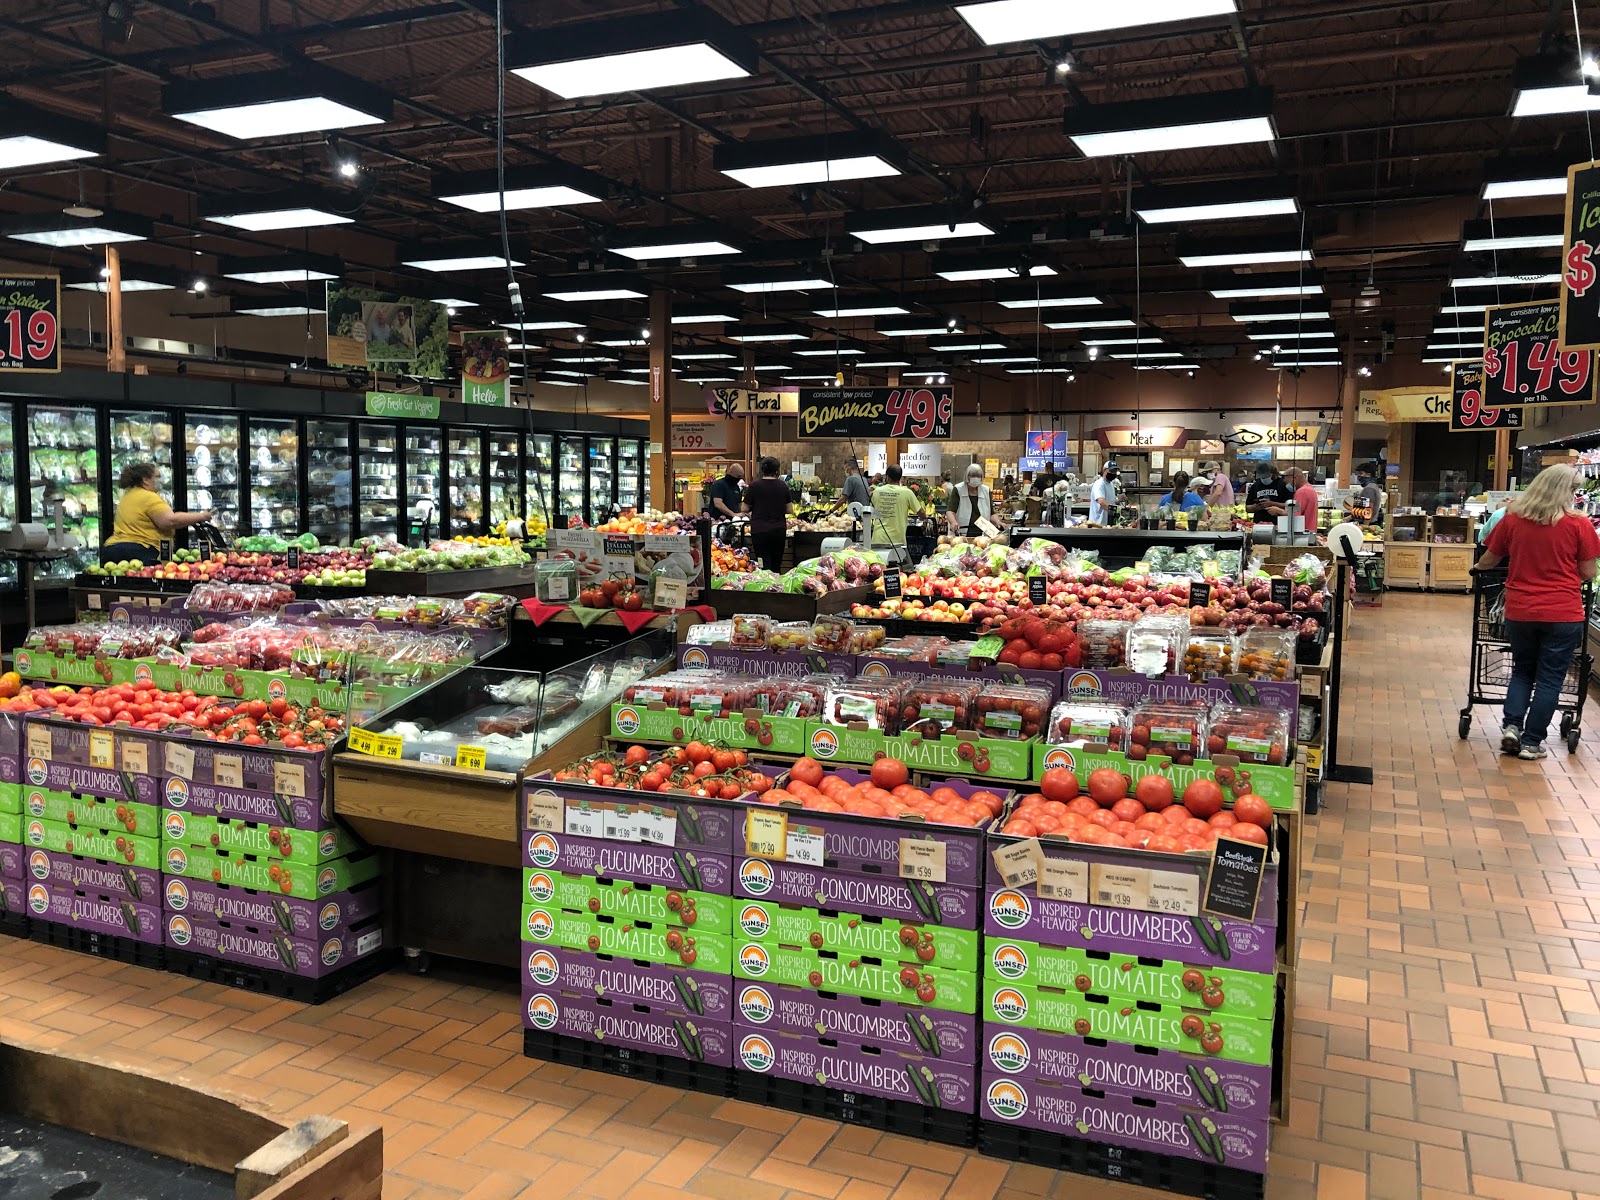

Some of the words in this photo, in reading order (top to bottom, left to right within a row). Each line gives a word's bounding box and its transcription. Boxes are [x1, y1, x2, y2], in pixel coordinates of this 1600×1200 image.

[8, 291, 51, 310] Salad
[1510, 307, 1540, 316] consistent
[1541, 306, 1552, 314] low
[1488, 317, 1544, 348] Broccoli
[1484, 339, 1591, 394] $1.49
[472, 385, 498, 404] Hello
[748, 393, 780, 411] Floral
[854, 390, 874, 399] prices!
[388, 398, 402, 411] Fresh
[404, 400, 413, 410] Cut
[414, 400, 434, 416] Veggies
[801, 402, 884, 434] Bananas
[936, 426, 946, 435] lb.
[1130, 432, 1154, 446] Meat
[1266, 428, 1308, 443] Seafood
[56, 660, 96, 678] TOMATES
[714, 656, 740, 666] INSPIRED
[744, 660, 810, 676] CONCOMBRES
[180, 673, 226, 692] TOMATOES
[1069, 688, 1100, 696] SUNSET
[1108, 680, 1142, 695] INSPIRED
[1148, 683, 1232, 704] CUCUMBERS
[644, 716, 674, 726] INSPIRED
[680, 716, 746, 742] TOMATOES
[812, 742, 838, 750] SUNSET
[844, 735, 876, 749] INSPIRED
[883, 740, 959, 768] TOMATES
[73, 768, 121, 792] CUCUMBERS
[72, 803, 118, 826] TOMATOES
[218, 792, 278, 816] CONCOMBRES
[71, 833, 117, 857] TOMATOES
[218, 824, 271, 850] TOMATES
[761, 842, 774, 856] $2.99
[600, 848, 676, 880] CUCUMBERS
[1217, 856, 1258, 874] Tomatoes
[1225, 850, 1254, 863] Beefsteak
[74, 866, 126, 890] CONCOMBRES
[218, 860, 270, 886] TOMATES
[917, 866, 932, 878] $5.99
[1020, 868, 1038, 880] $5.99
[740, 876, 774, 886] SUNSET
[780, 870, 816, 886] INSPIRED
[820, 878, 912, 910] CONCOMBRES
[1056, 887, 1072, 898] $5.49
[1114, 894, 1130, 905] $3.99
[74, 900, 124, 926] CUCUMBERS
[218, 898, 276, 924] CONCOMBRES
[598, 888, 666, 918] TOMATES
[1162, 900, 1180, 912] $2.49
[992, 908, 1031, 920] SUNSET
[1039, 902, 1082, 920] INSPIRED
[1088, 908, 1192, 944] CUCUMBERS
[220, 934, 279, 960] CONCOMBRES
[598, 926, 666, 957] TOMATES
[818, 920, 900, 954] TOMATOES
[600, 970, 676, 1002] CUCUMBERS
[818, 960, 902, 995] TOMATES
[994, 961, 1028, 972] SUNSET
[1036, 956, 1078, 972] INSPIRED
[1088, 964, 1182, 1000] TOMATES
[600, 1015, 678, 1048] CONCOMBRES
[741, 1002, 773, 1014] SUNSET
[780, 1000, 815, 1016] INSPIRED
[820, 1008, 911, 1043] CONCOMBRES
[782, 1014, 812, 1028] FLAVOR
[994, 1004, 1027, 1016] SUNSET
[1036, 1000, 1078, 1016] INSPIRED
[1088, 1008, 1181, 1045] TOMATES
[1038, 1014, 1074, 1030] FLAVOR
[741, 1052, 774, 1064] SUNSET
[780, 1048, 816, 1065] INSPIRED
[822, 1056, 910, 1094] CUCUMBERS
[784, 1062, 814, 1078] FLAVOR
[990, 1052, 1028, 1064] SUNSET
[1037, 1048, 1079, 1066] INSPIRED
[1085, 1058, 1192, 1097] CONCOMBRES
[1040, 1062, 1076, 1078] FLAVOR
[988, 1098, 1027, 1111] SUNSET
[1035, 1095, 1076, 1114] INSPIRED
[1082, 1106, 1190, 1146] CONCOMBRES
[1038, 1110, 1074, 1126] FLAVOR
